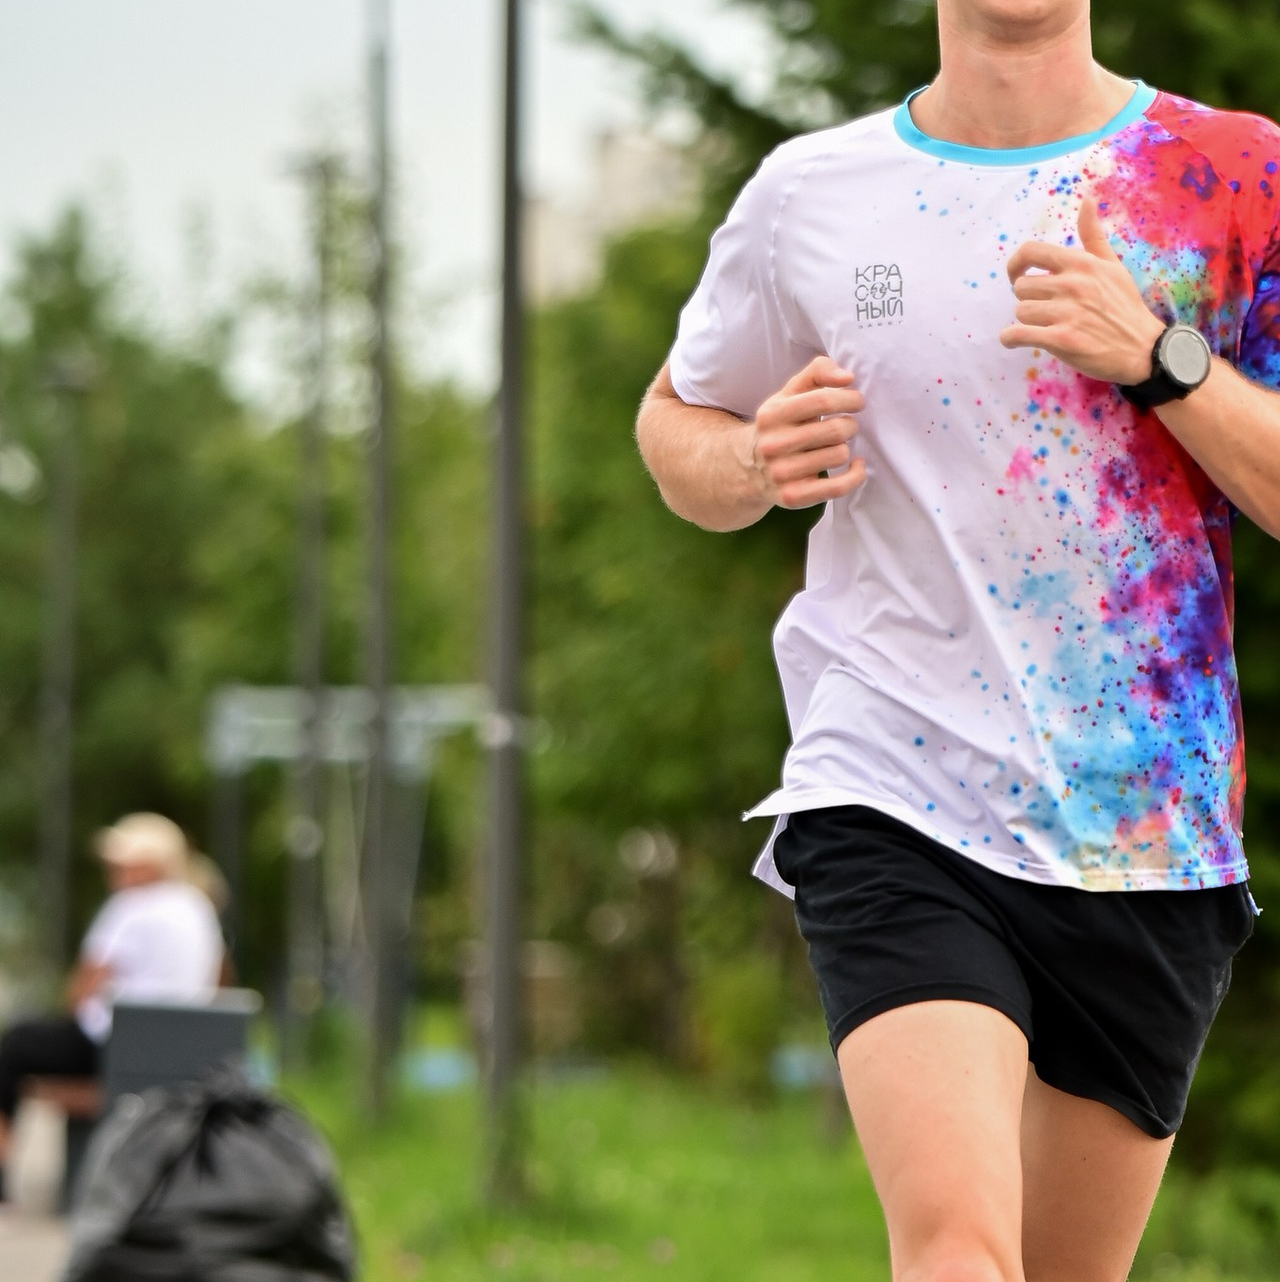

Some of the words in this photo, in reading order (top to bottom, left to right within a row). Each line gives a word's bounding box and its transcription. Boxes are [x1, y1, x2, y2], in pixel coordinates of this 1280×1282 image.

[855, 264, 902, 284] КРА
[855, 281, 902, 301] СОЧ
[856, 297, 903, 321] НЫЙ
